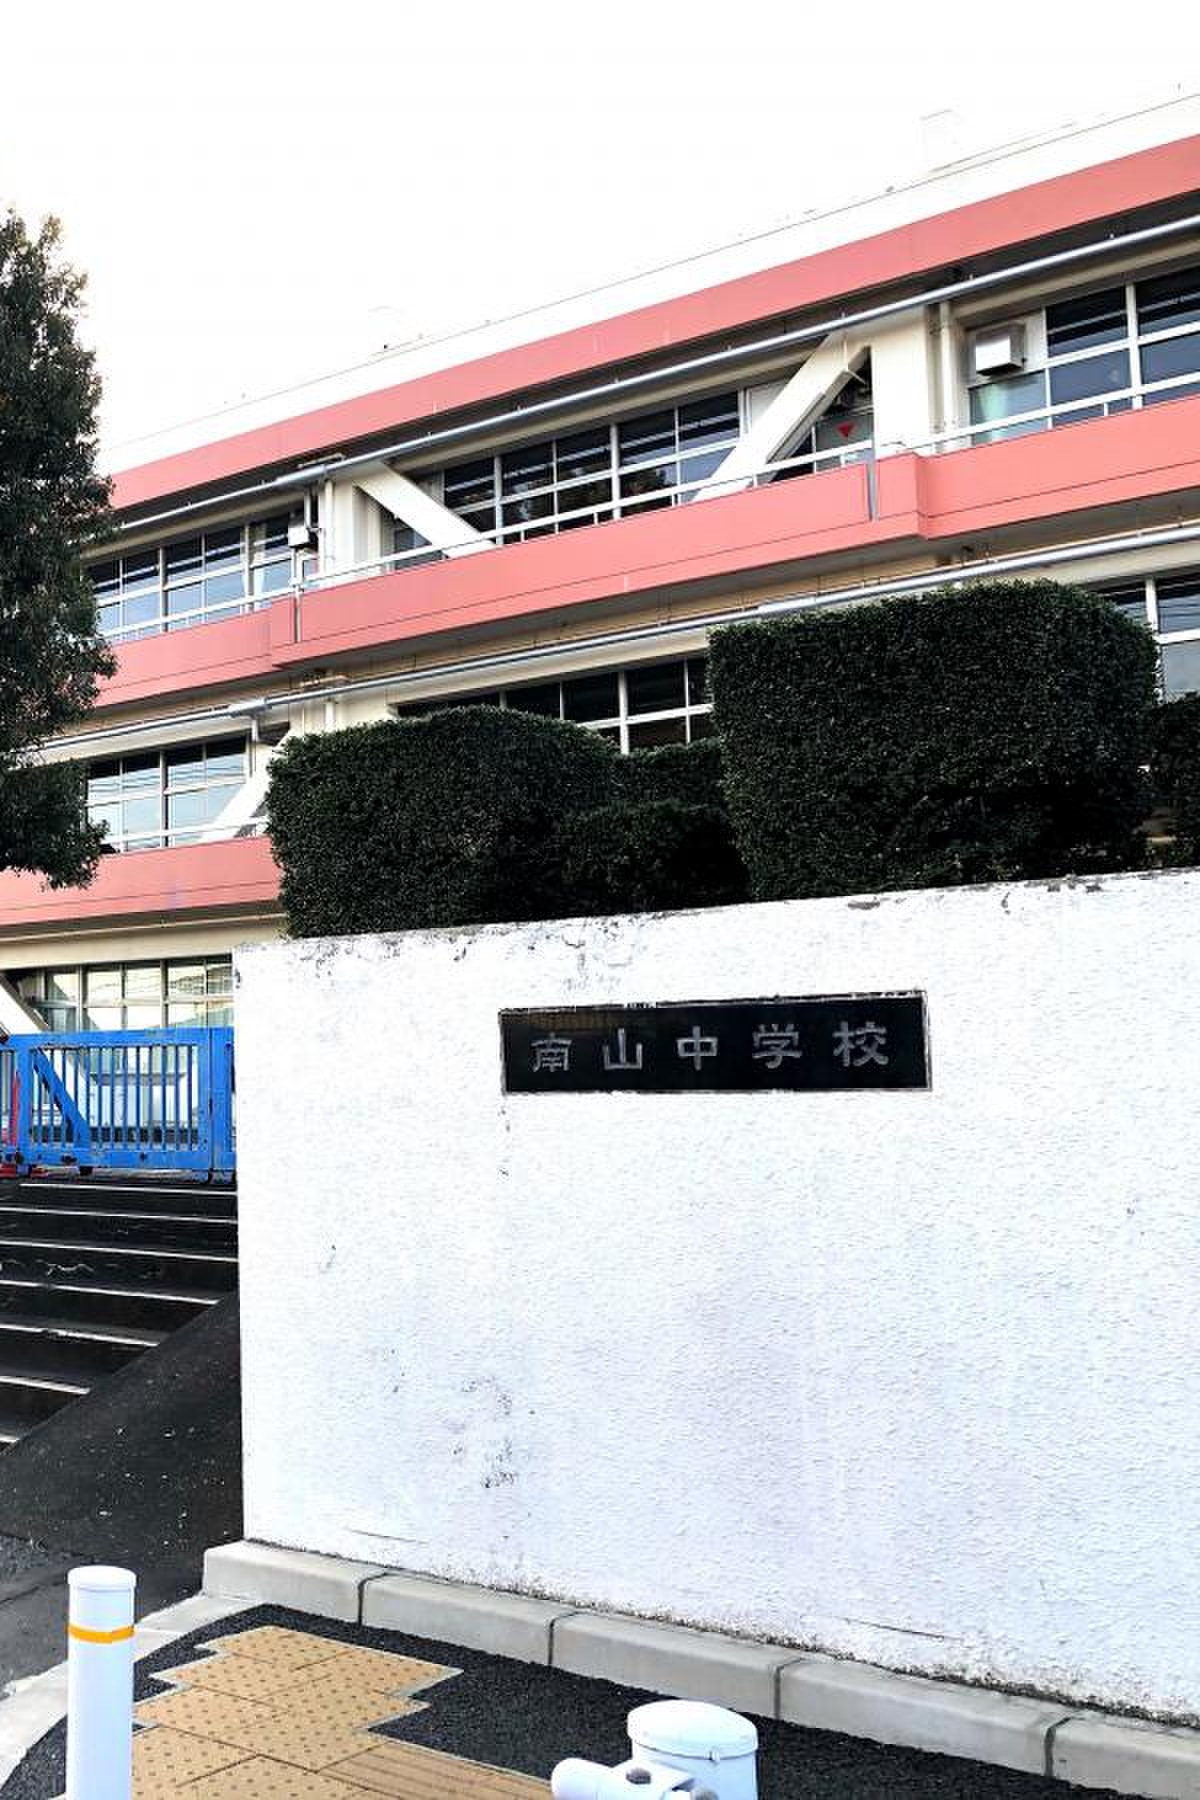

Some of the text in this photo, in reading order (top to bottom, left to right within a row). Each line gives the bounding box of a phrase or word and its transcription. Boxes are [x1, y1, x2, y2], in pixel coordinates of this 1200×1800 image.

[529, 1021, 889, 1072] 南山中学校
